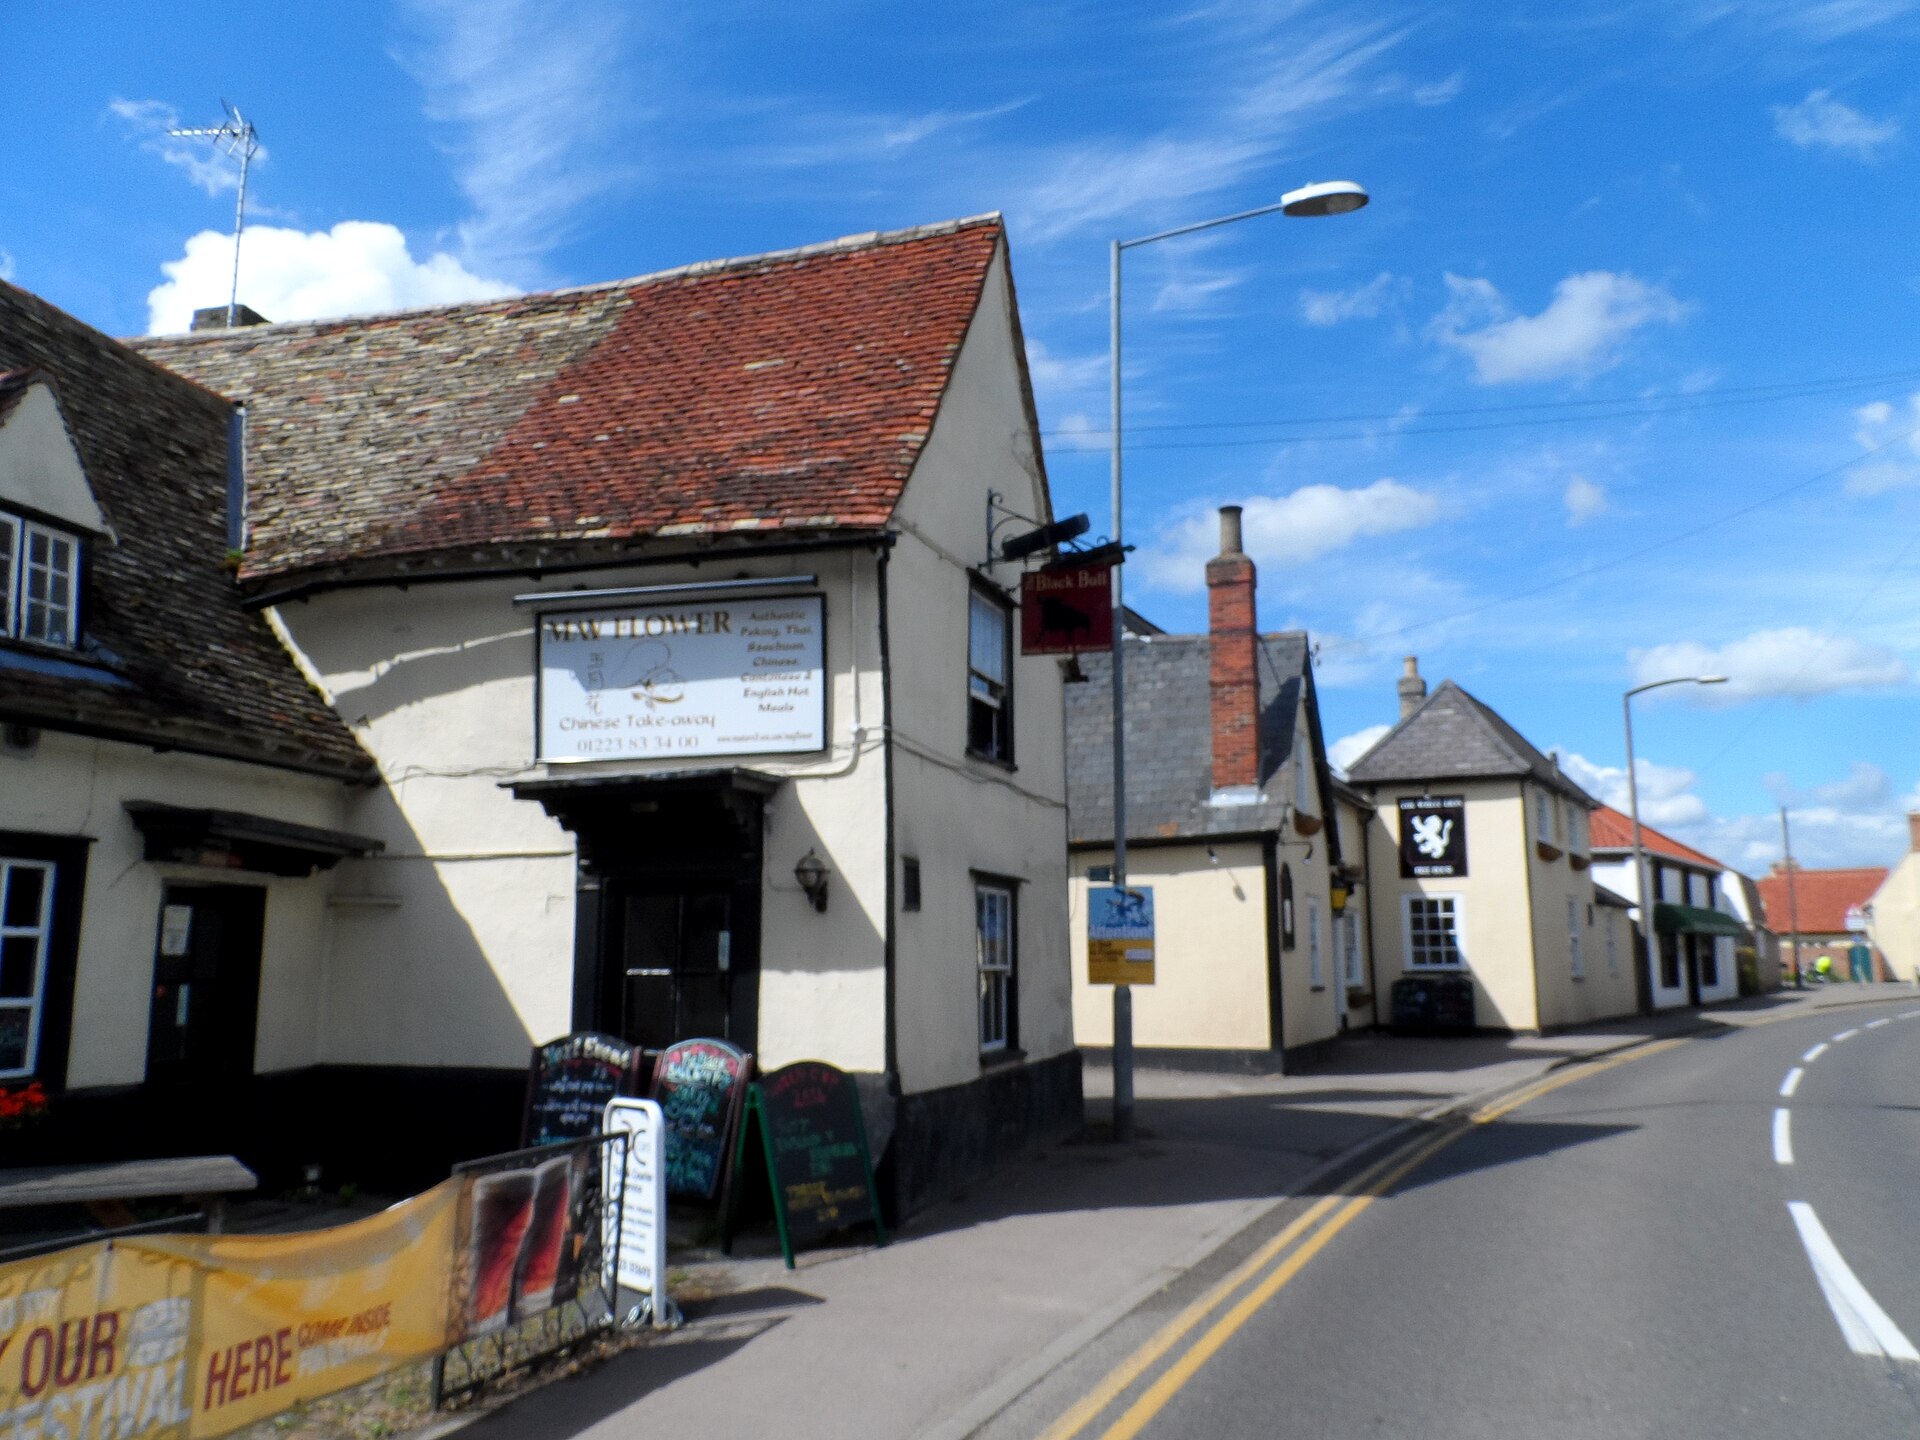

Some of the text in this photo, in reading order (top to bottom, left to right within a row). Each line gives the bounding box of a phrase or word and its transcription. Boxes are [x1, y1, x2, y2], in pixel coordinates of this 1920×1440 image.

[1036, 573, 1074, 592] Black
[1078, 569, 1108, 588] Bull
[614, 610, 731, 640] FLOWER
[743, 686, 809, 699] English Hot
[559, 713, 715, 731] Chinese Take-away
[577, 737, 622, 753] 01223
[679, 734, 699, 750] 00
[20, 1311, 119, 1399] OUR
[203, 1326, 292, 1413] HERE
